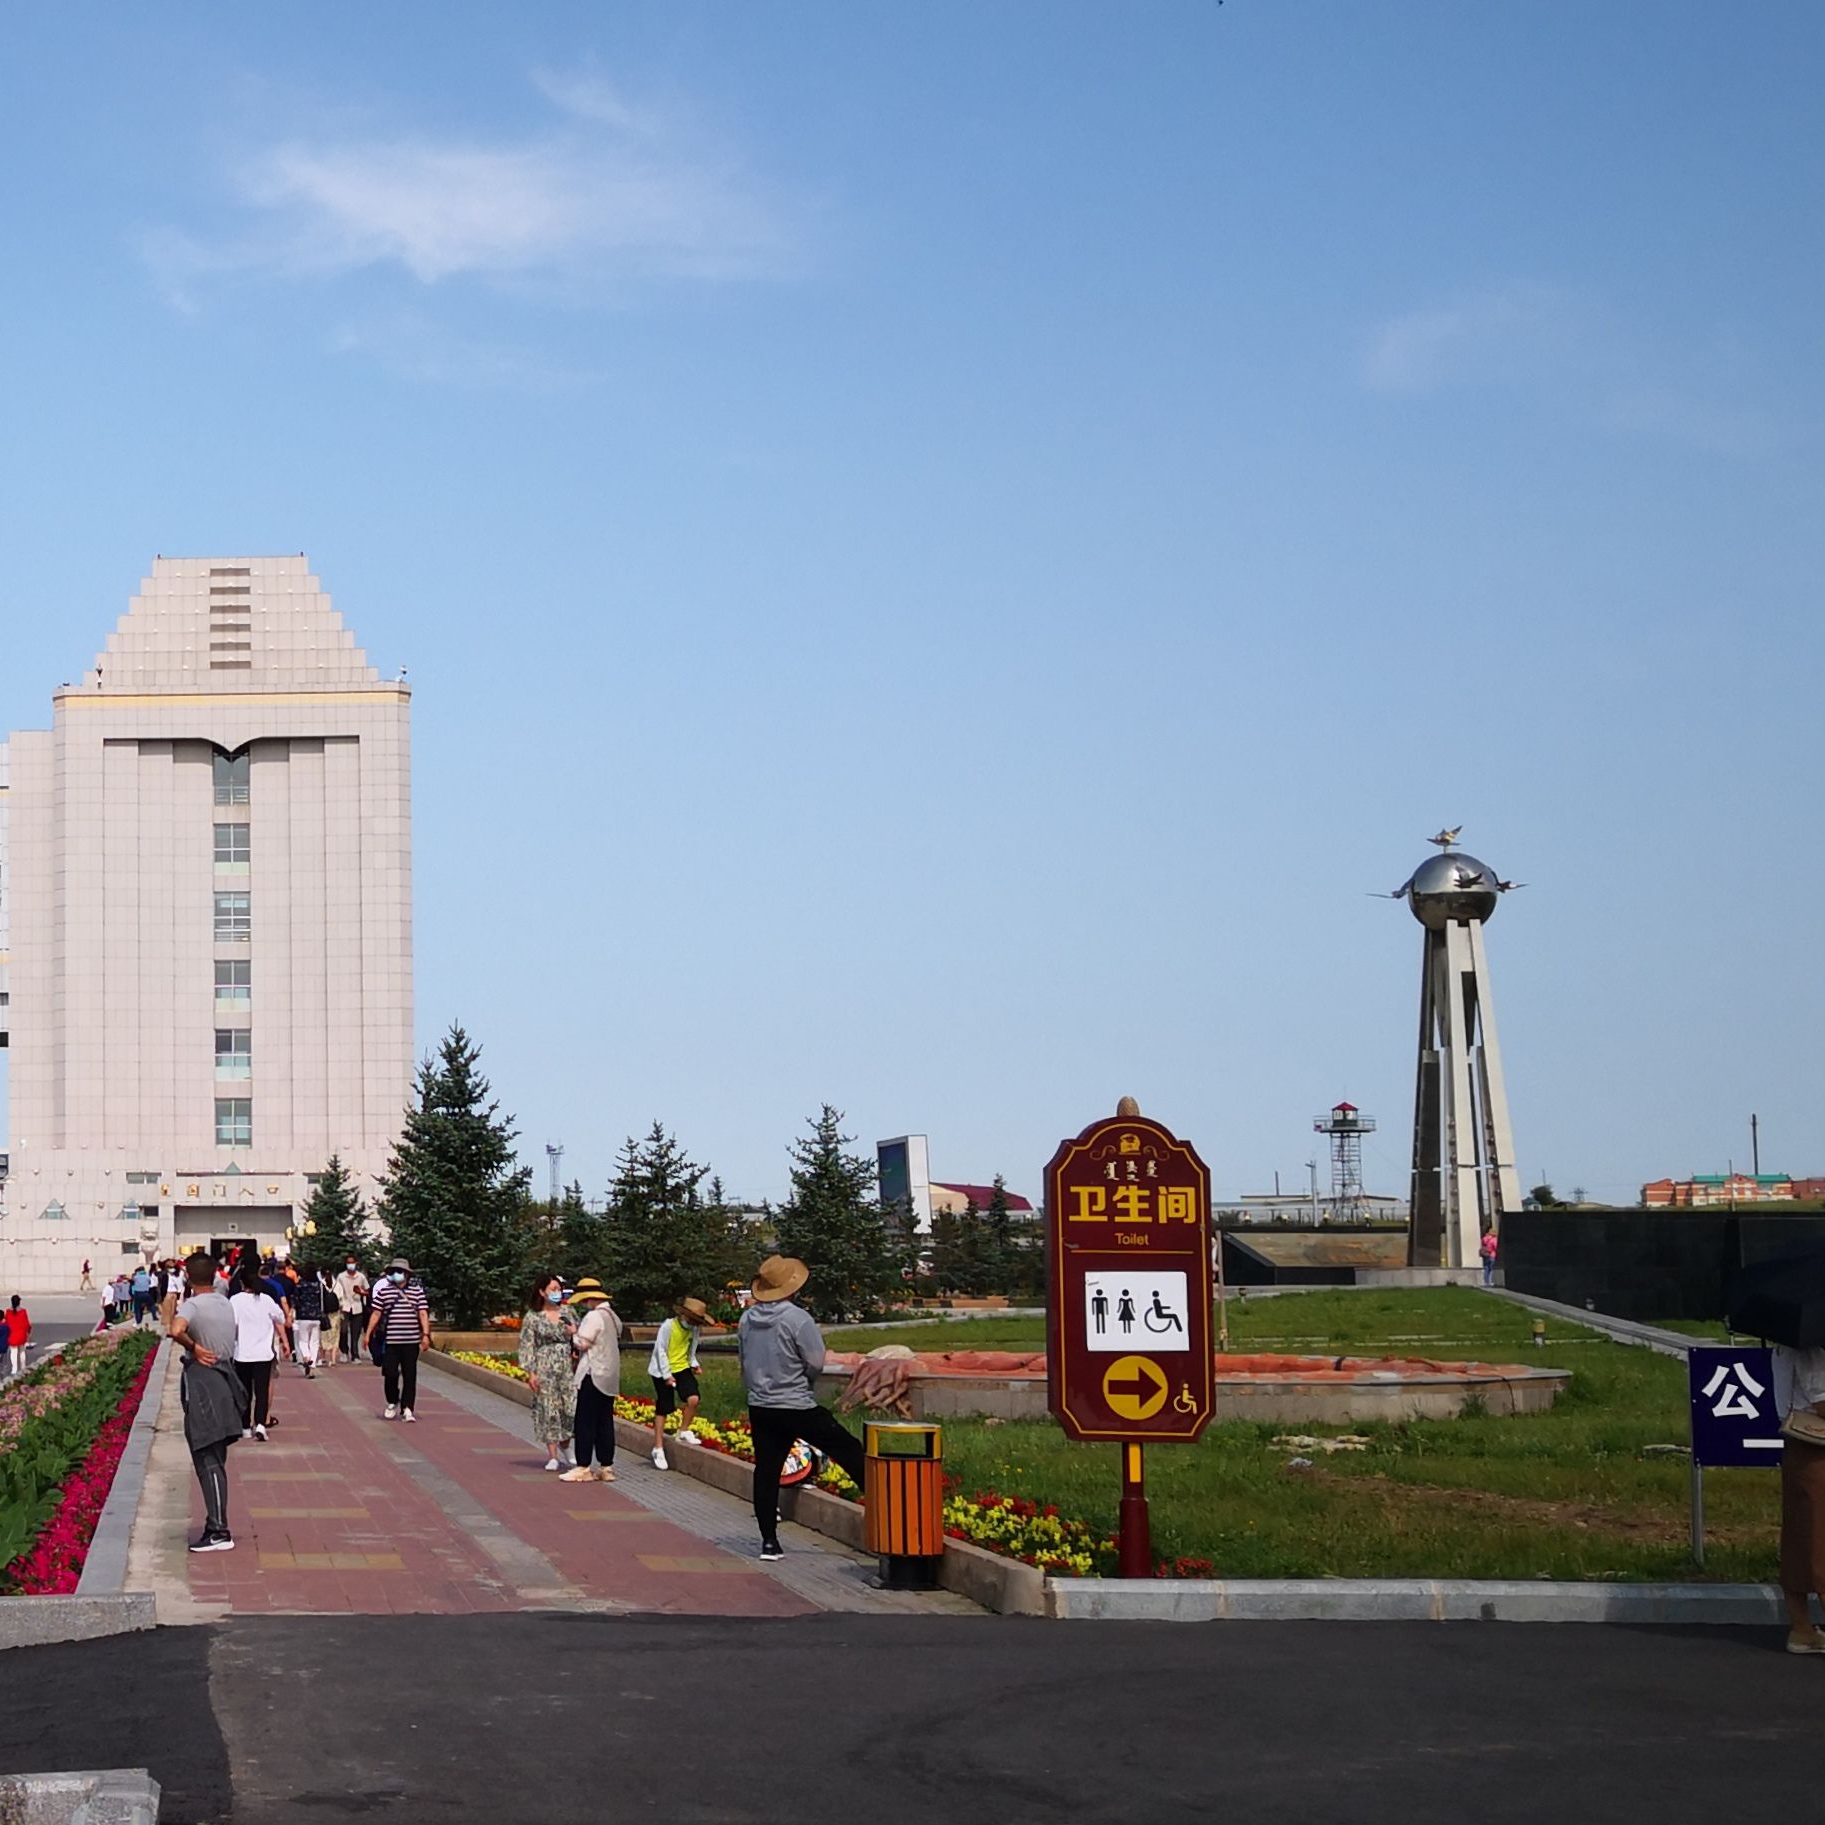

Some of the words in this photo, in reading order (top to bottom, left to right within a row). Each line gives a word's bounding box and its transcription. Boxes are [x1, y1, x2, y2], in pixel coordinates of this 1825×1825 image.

[1069, 1185, 1196, 1224] 卫生间
[1115, 1233, 1149, 1245] Toilet
